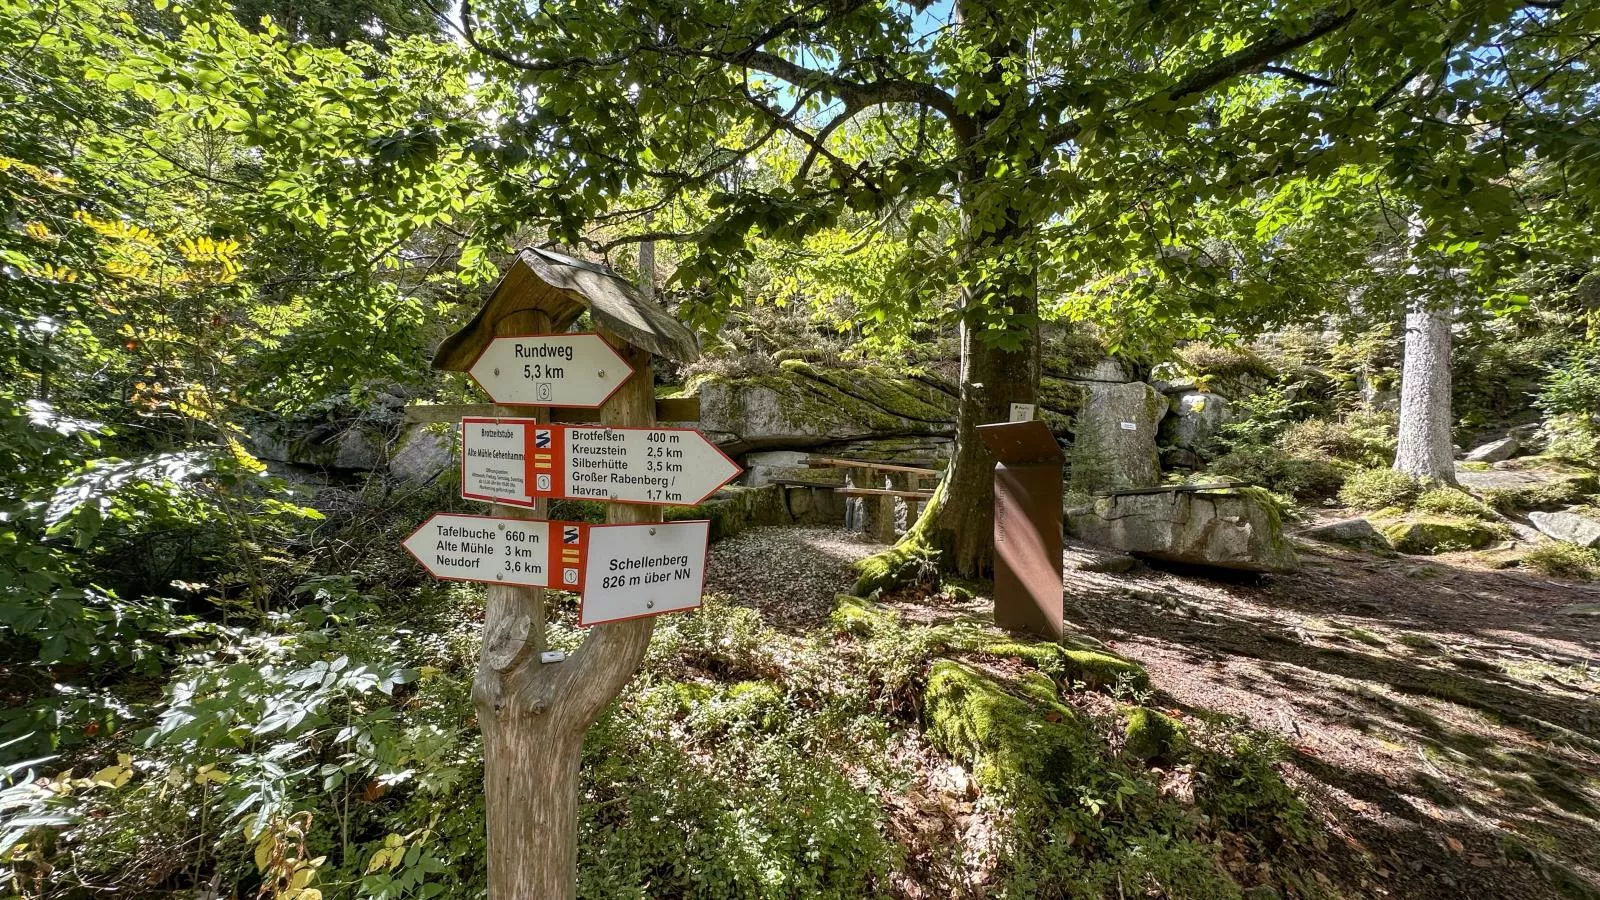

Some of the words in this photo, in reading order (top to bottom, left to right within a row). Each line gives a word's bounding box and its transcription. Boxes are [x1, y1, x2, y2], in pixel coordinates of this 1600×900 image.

[515, 343, 573, 360] Rundweg
[524, 364, 541, 381] 5,3
[546, 365, 564, 379] km
[482, 428, 514, 438] Brotzeitstube
[572, 430, 625, 442] Brotfelsen
[647, 432, 666, 443] 400
[669, 435, 679, 443] m
[468, 447, 476, 456] Alte
[478, 448, 492, 458] Mühle
[493, 450, 525, 460] Gehenhamm
[572, 444, 626, 456] Kreuzstein
[647, 447, 663, 459] 2,5
[666, 448, 683, 458] km
[572, 458, 628, 470] Silberhütte
[647, 461, 663, 472] 3,5
[666, 462, 682, 472] km
[572, 472, 607, 483] Großer
[610, 474, 668, 488] Rabenberg
[572, 486, 608, 497] Havran
[647, 490, 662, 501] 1,7
[666, 491, 682, 501] km
[437, 525, 496, 540] Tafelbuche
[505, 530, 525, 542] 660
[529, 534, 539, 543] m
[436, 540, 458, 552] Alte
[461, 542, 494, 554] Mühle
[505, 546, 512, 556] 3
[515, 546, 532, 558] km
[436, 555, 480, 568] Neudorf
[505, 561, 521, 573] 3,6
[525, 562, 542, 574] km
[609, 554, 688, 571] Schellenberg
[602, 575, 626, 589] 826
[629, 576, 640, 586] m
[644, 572, 671, 584] über
[674, 568, 691, 580] NN
